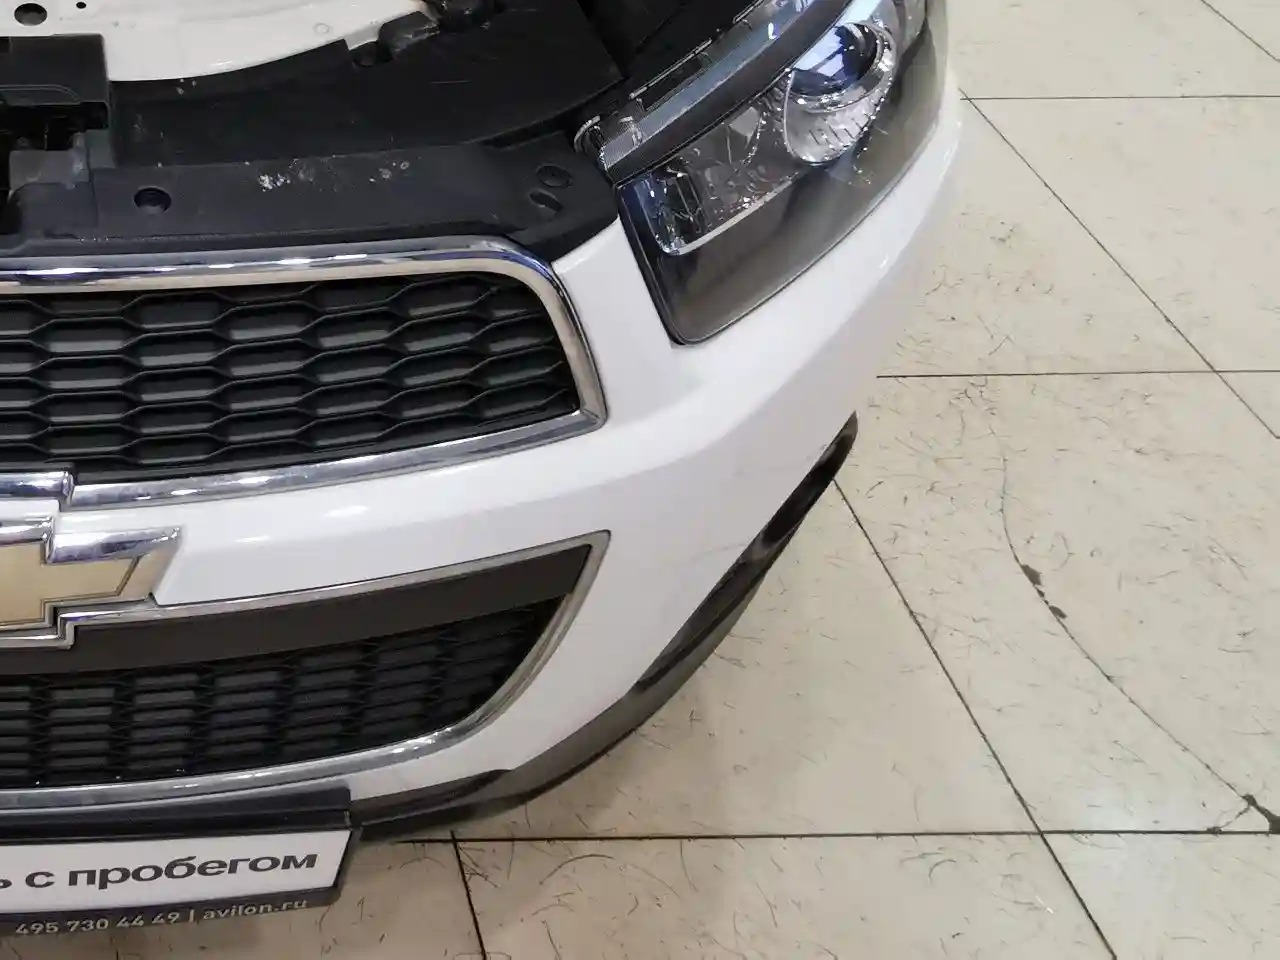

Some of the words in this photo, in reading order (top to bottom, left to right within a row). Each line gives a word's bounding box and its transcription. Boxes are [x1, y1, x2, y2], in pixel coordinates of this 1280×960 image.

[24, 871, 56, 889] с
[68, 853, 319, 891] пробегом
[15, 921, 60, 935] 495
[66, 918, 109, 933] 730
[116, 913, 145, 929] 44
[151, 911, 180, 926] 49
[203, 899, 308, 920] avilon.ru
